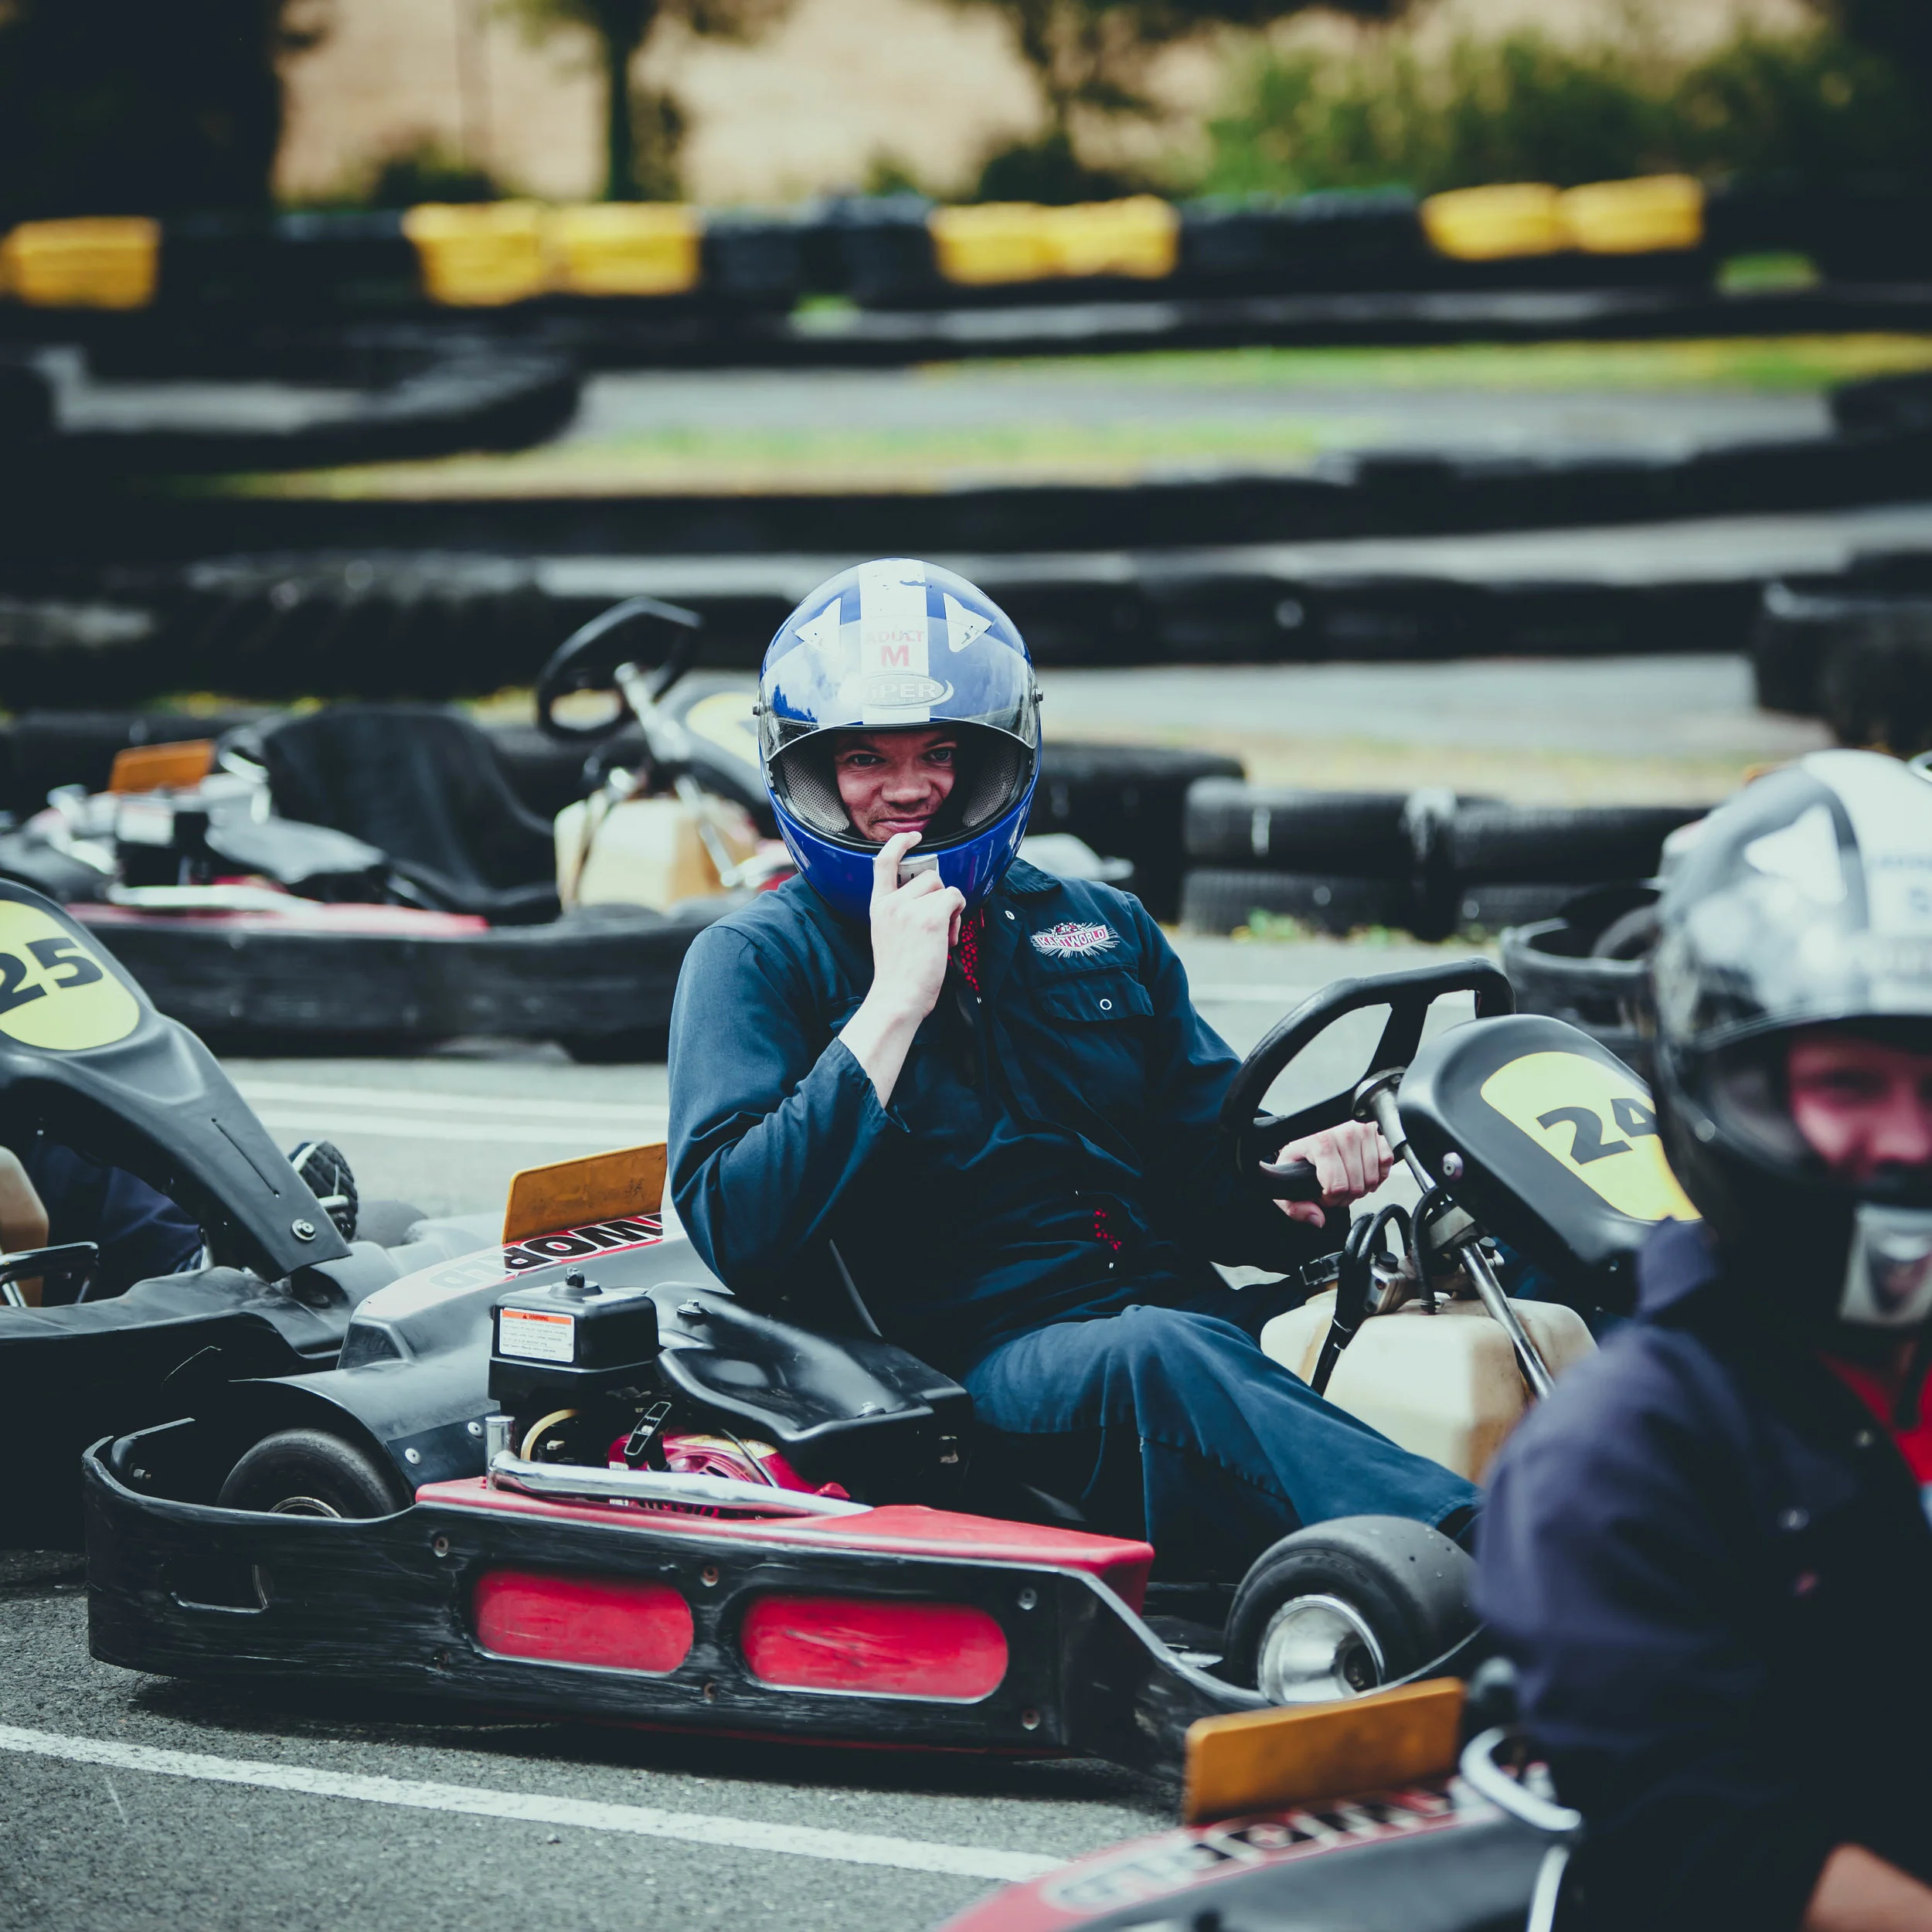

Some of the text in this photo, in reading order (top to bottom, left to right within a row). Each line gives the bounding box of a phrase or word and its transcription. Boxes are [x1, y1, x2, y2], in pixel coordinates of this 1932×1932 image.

[881, 645, 910, 667] M
[865, 683, 937, 699] IPER
[0, 937, 104, 1015] 25
[1536, 1097, 1658, 1165] 24
[427, 1213, 663, 1289] WORLD
